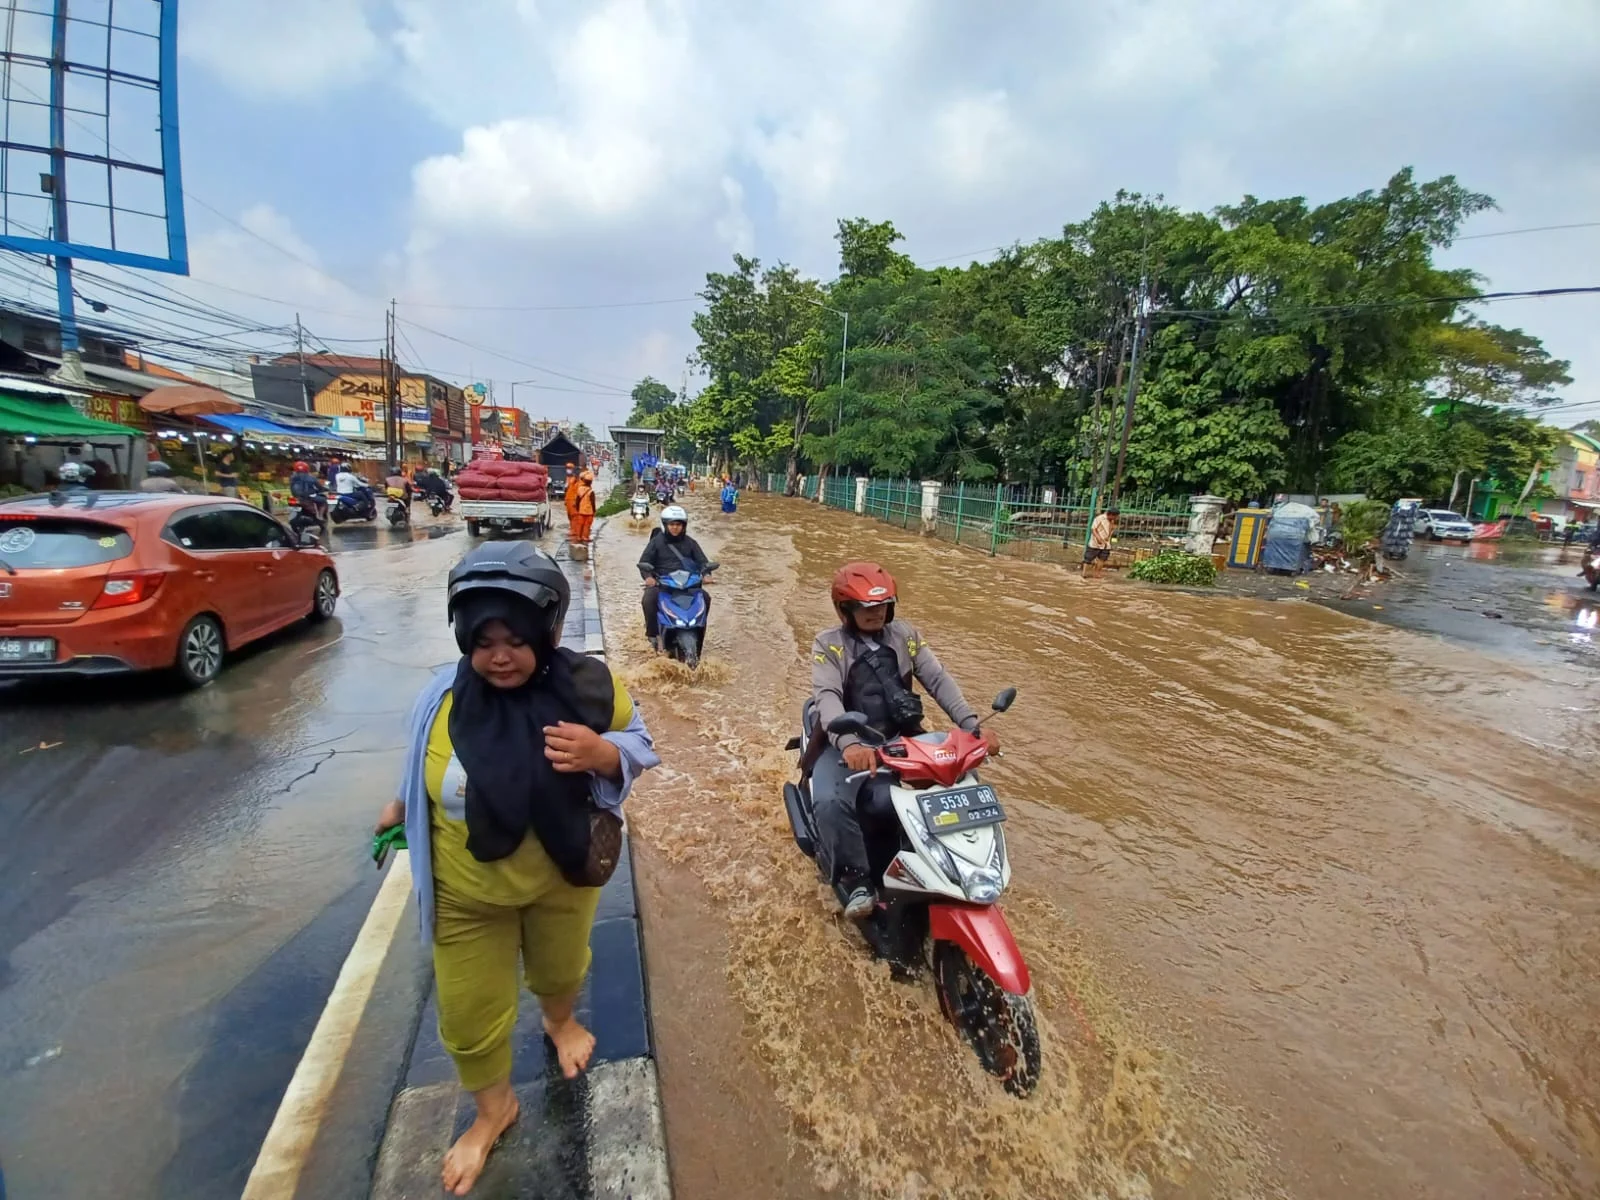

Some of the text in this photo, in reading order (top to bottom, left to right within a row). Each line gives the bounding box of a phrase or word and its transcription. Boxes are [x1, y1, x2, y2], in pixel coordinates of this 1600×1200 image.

[340, 379, 370, 397] 24
[923, 799, 932, 813] F
[940, 793, 970, 810] 5538
